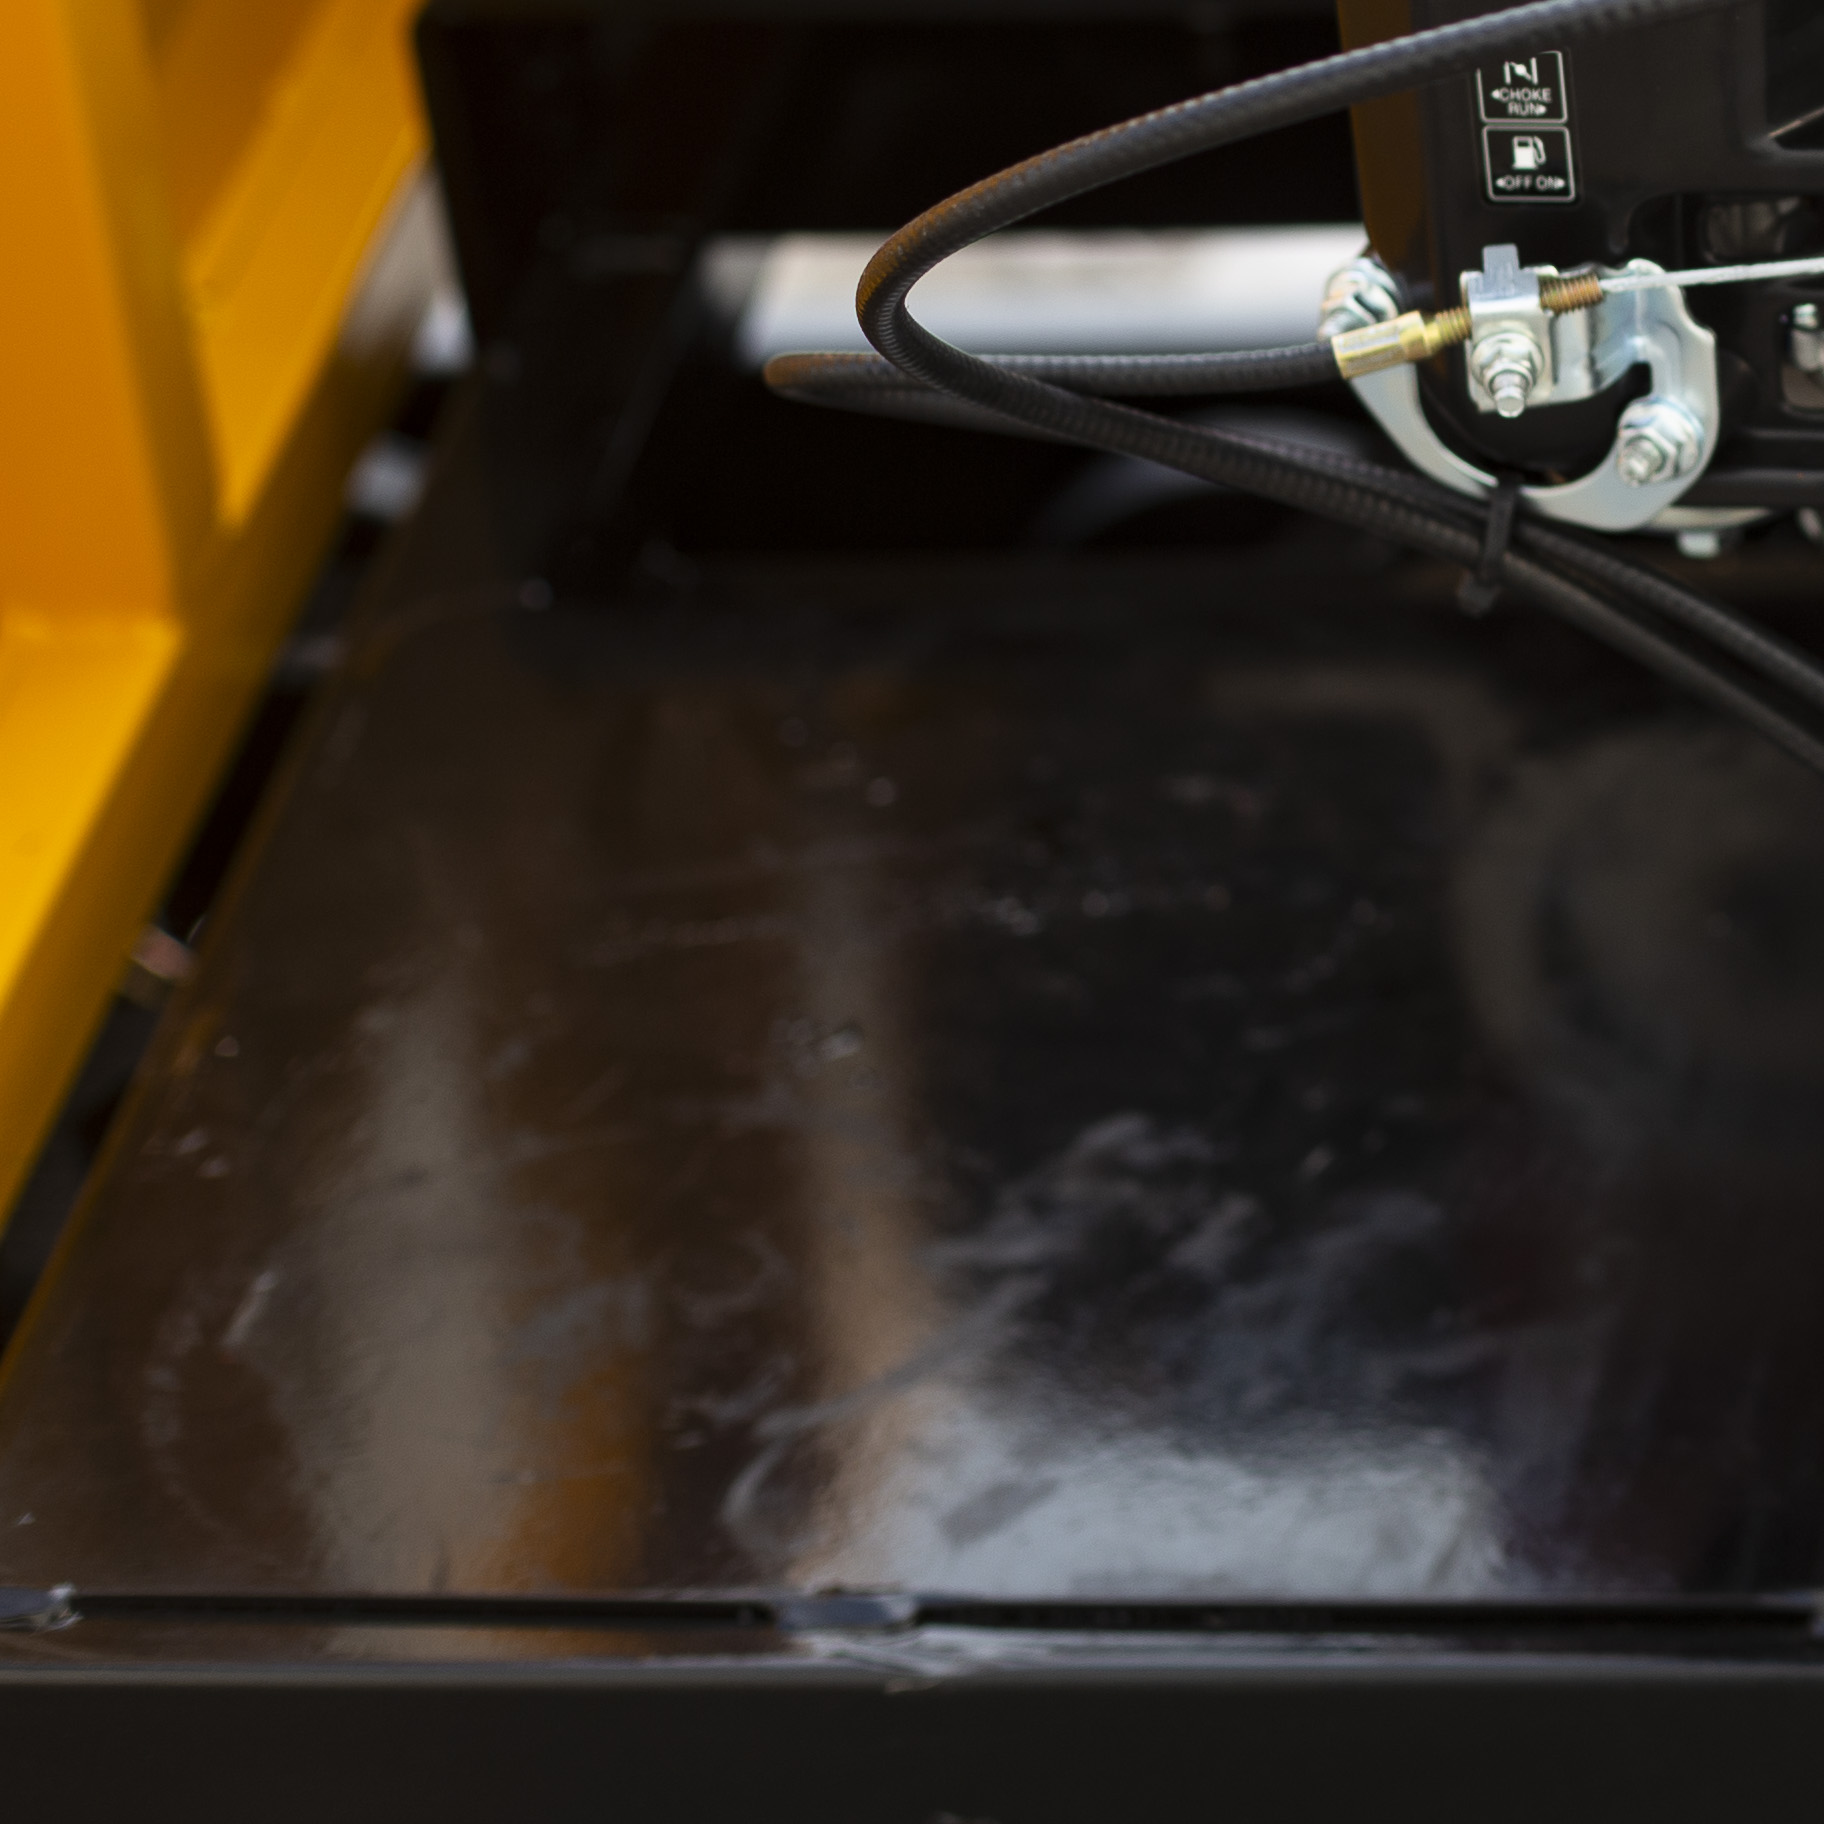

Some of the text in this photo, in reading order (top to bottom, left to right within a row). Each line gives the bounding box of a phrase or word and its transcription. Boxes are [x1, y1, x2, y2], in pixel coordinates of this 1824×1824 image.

[1500, 87, 1552, 102] CHOKE
[1508, 102, 1539, 116] RUN
[1504, 175, 1532, 190] OFF
